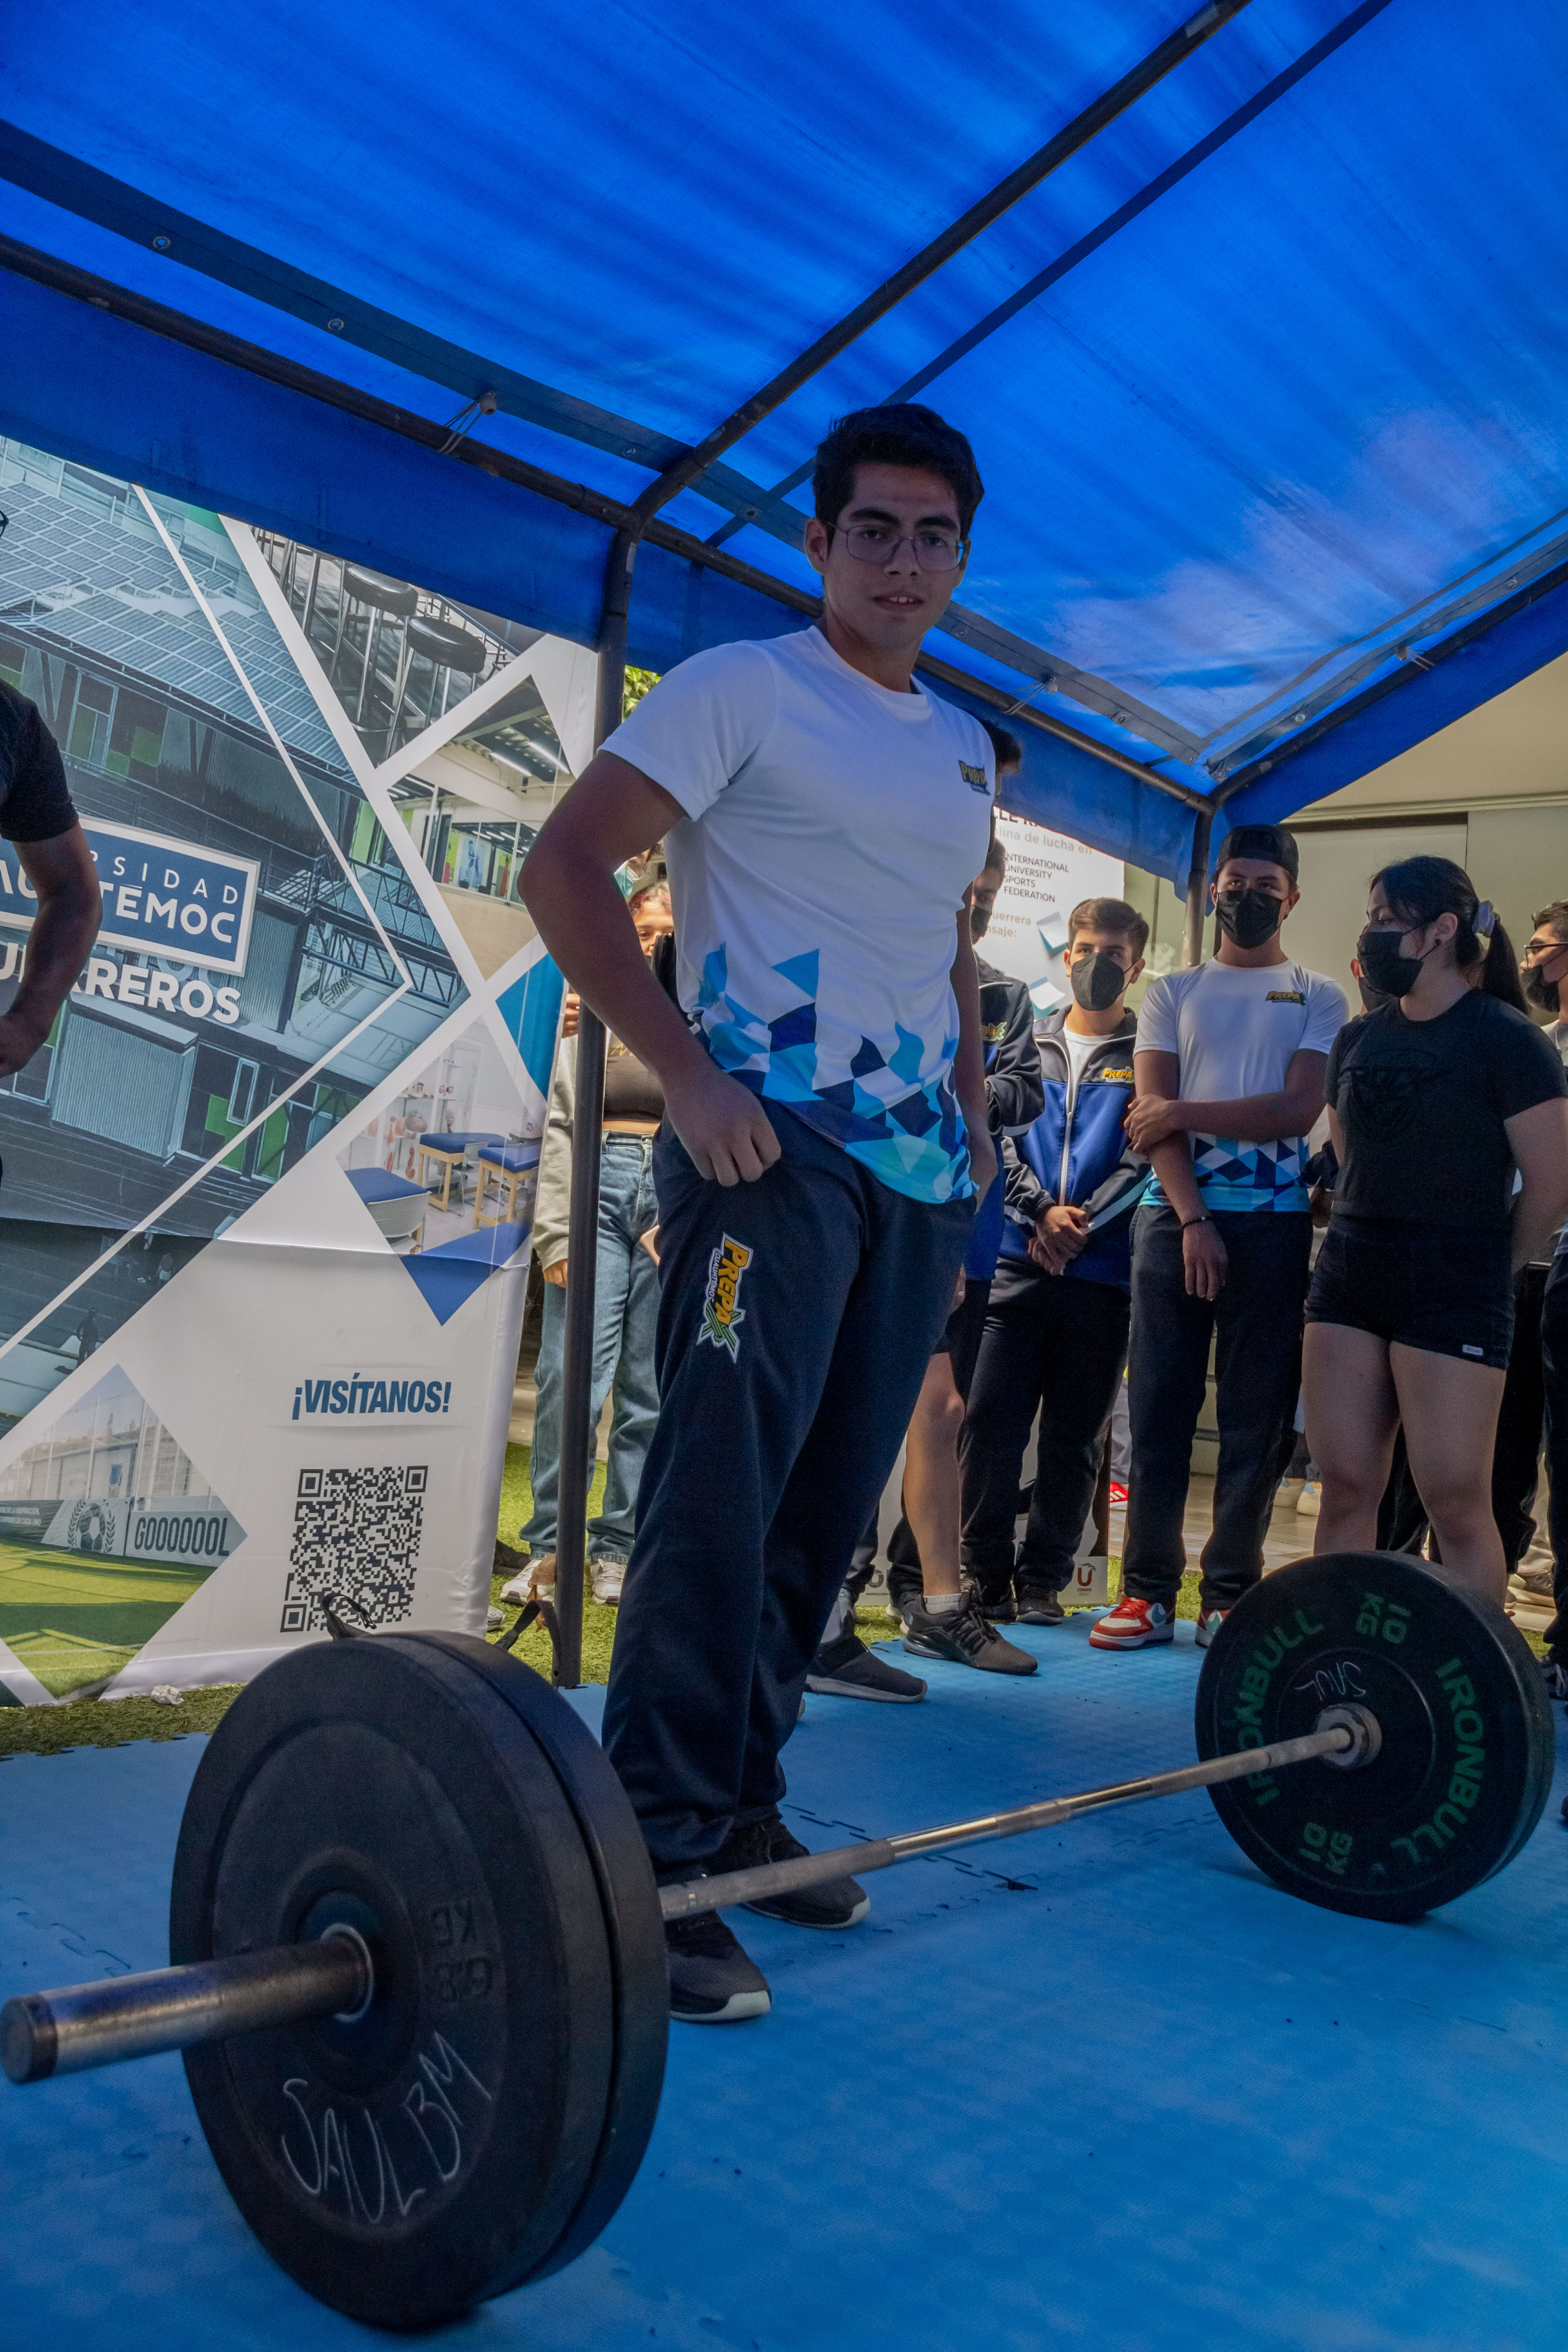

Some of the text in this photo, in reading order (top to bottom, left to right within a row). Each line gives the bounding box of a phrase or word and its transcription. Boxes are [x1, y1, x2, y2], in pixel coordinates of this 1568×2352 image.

[995, 826, 1020, 840] lina
[1024, 832, 1039, 843] de
[1044, 836, 1074, 851] lucha
[1004, 874, 1035, 888] SPORTS
[1005, 864, 1052, 879] UNIVERSITY
[1004, 886, 1056, 902] FEDERATION
[988, 926, 1016, 938] nsaje:
[992, 911, 1031, 926] uerrera
[1102, 1068, 1132, 1078] PREPA
[715, 1239, 750, 1325] PREPA
[292, 1372, 452, 1420] ¡VISÍTANOS!
[134, 1517, 230, 1557] GOOOOOOL
[1356, 1592, 1383, 1636] KG
[1389, 1657, 1486, 1865] IRONBULL
[1325, 1830, 1354, 1876] KG
[280, 2030, 492, 2225] SAUL BM
